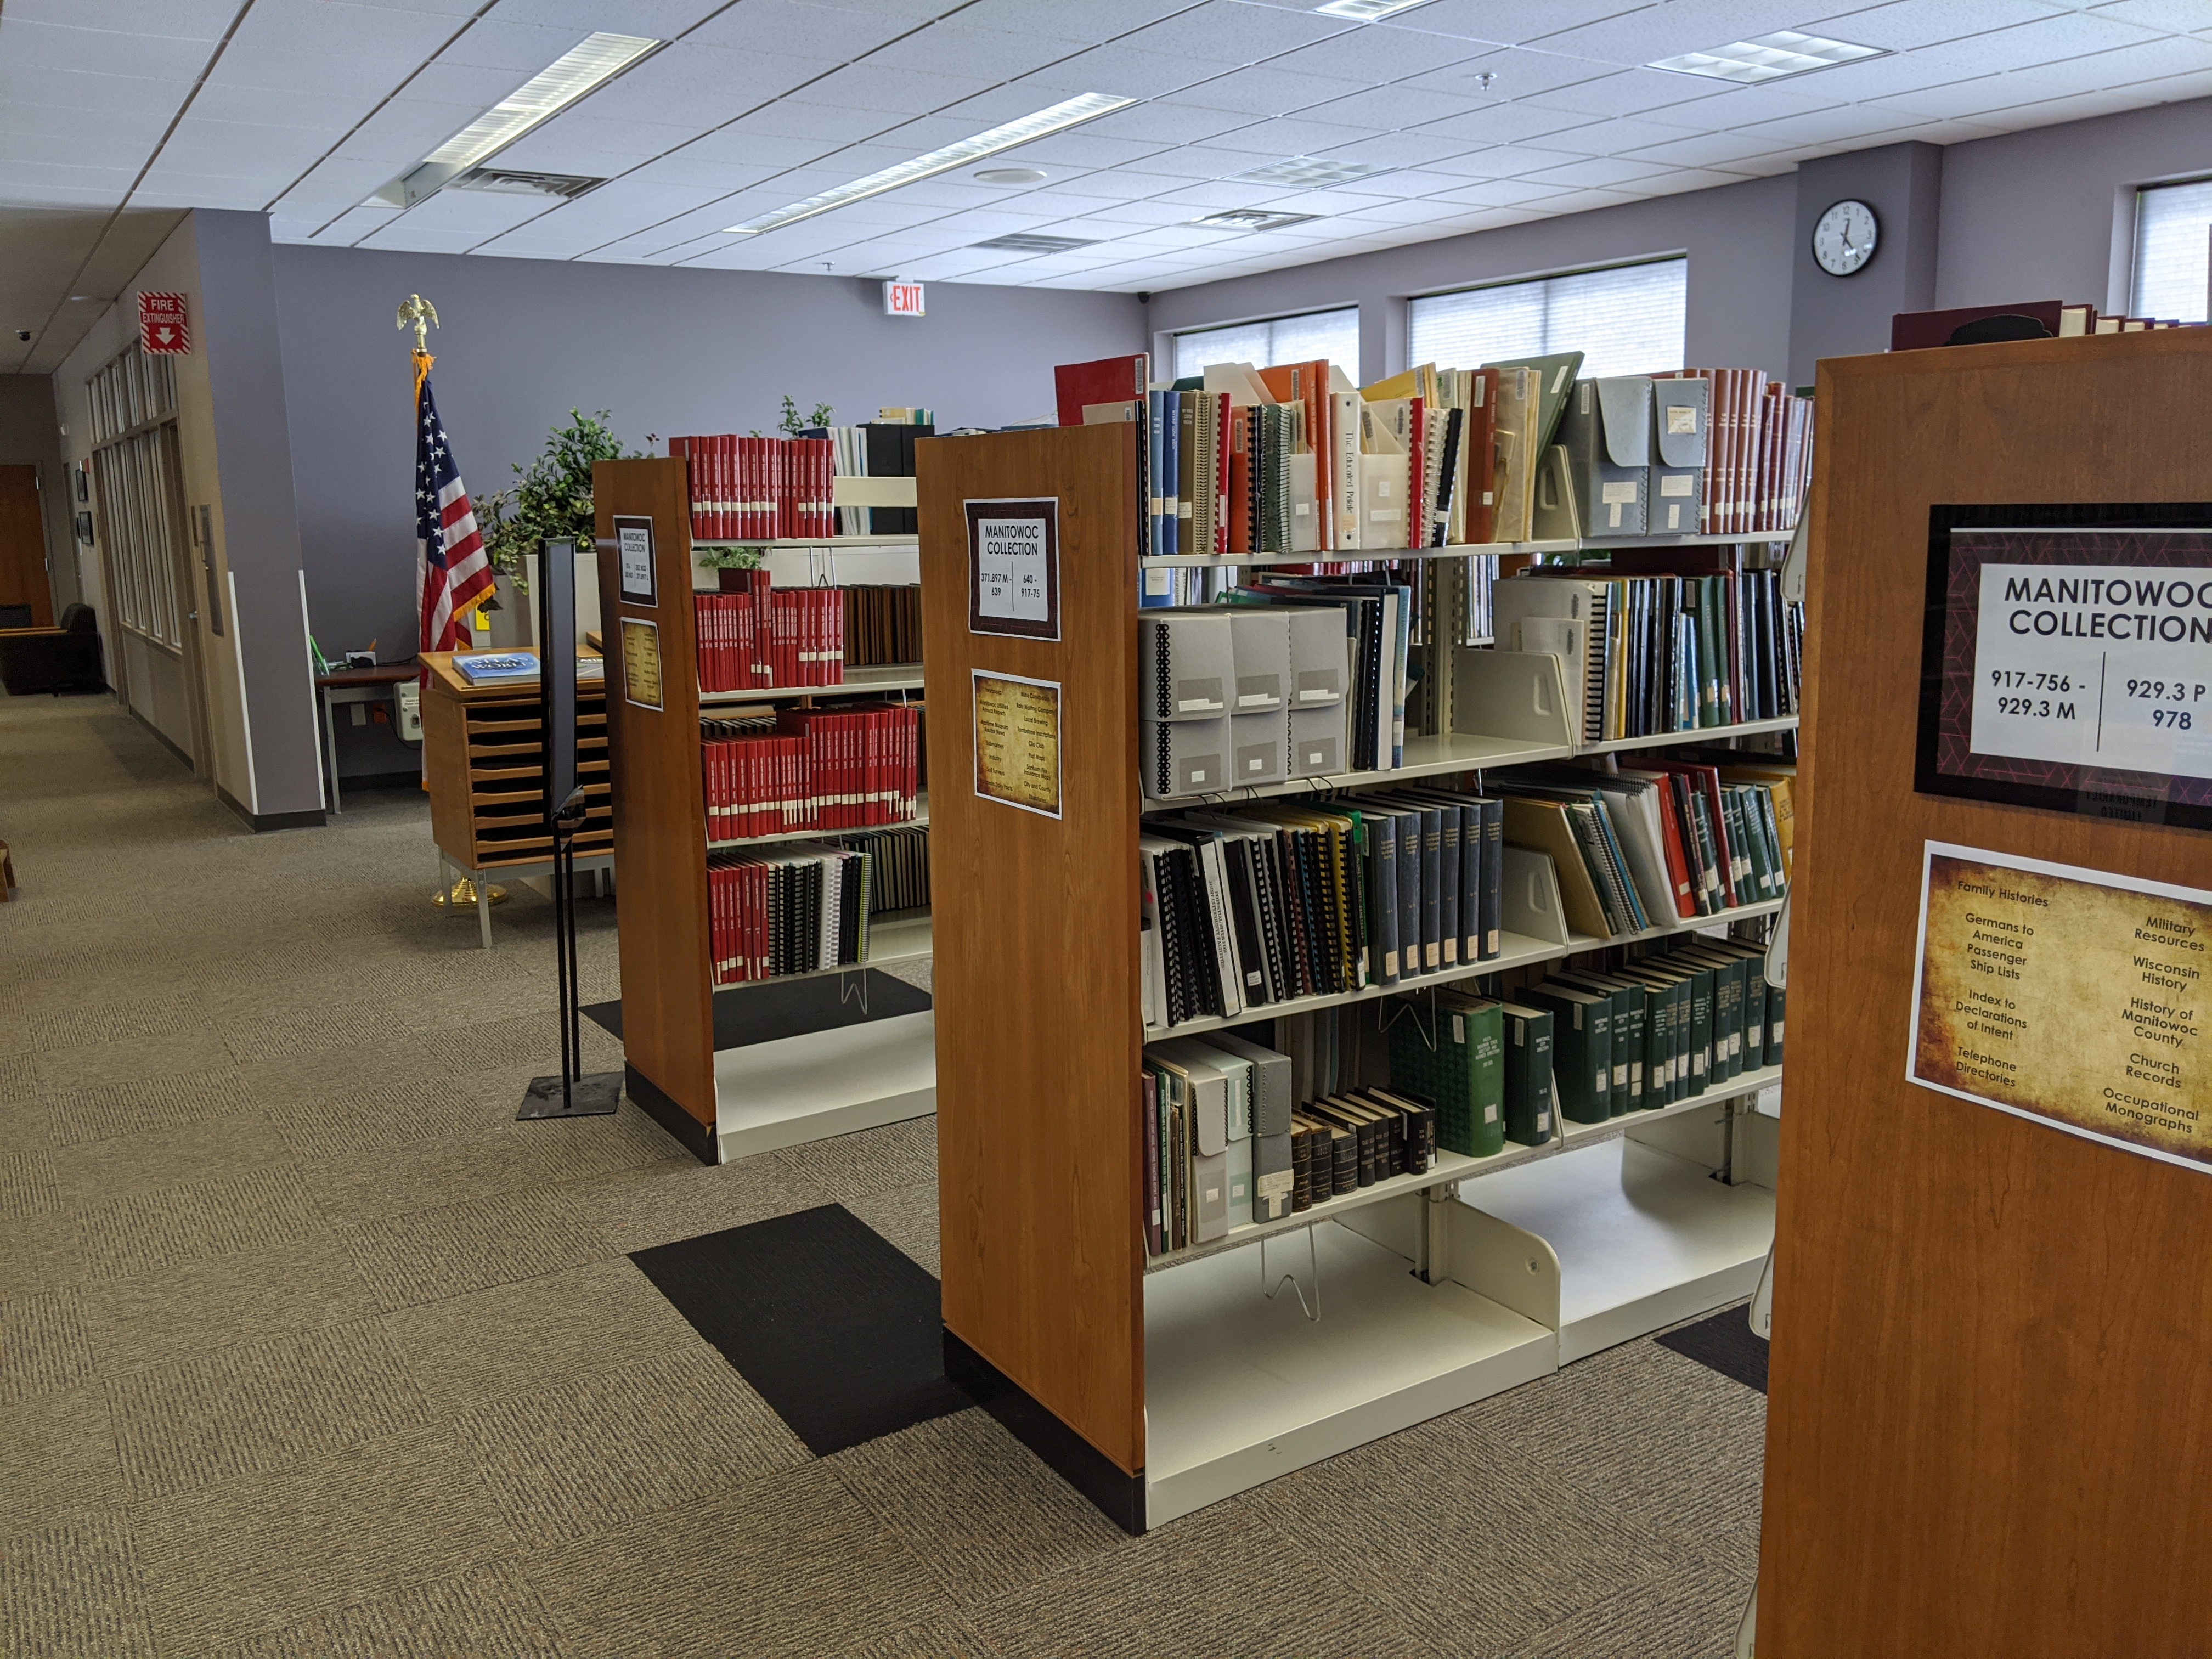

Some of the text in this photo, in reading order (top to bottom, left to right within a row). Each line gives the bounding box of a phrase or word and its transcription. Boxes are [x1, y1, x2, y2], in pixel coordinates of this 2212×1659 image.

[151, 299, 174, 311] FIRE
[893, 286, 920, 312] EXIT
[143, 313, 185, 324] EXTINGUISHER
[1346, 452, 1354, 487] Educated
[985, 526, 1039, 539] MANITOWOC
[987, 542, 1037, 556] COLLECTION
[981, 573, 1002, 583] 371.897
[1002, 574, 1008, 583] M
[1023, 574, 1033, 584] 640
[991, 587, 1001, 596] 639
[1021, 588, 1040, 598] 917-75
[2004, 577, 2212, 608] MANITOWOC
[2009, 609, 2212, 644] COLLECTION
[1991, 670, 2070, 692] 917-756
[2126, 679, 2206, 702] 929.3 P
[1997, 697, 2076, 720] 929.3 M
[2152, 710, 2192, 730] 978
[1957, 881, 2049, 907] Family Histories
[1215, 891, 1223, 924] POTENTIAL
[1211, 899, 1221, 936] CITY/COUNTY
[1217, 936, 1226, 969] FACILITIES
[1965, 912, 2034, 936] Germans to
[2146, 916, 2196, 938] Military
[1973, 930, 2024, 950] America
[2135, 928, 2205, 952] Resources
[1967, 944, 2028, 967] Passenger
[1971, 960, 2021, 980] Ship Lists
[2133, 956, 2200, 980] Wisconsin
[2142, 971, 2188, 993] History
[1969, 989, 2016, 1010] Index to
[2131, 996, 2194, 1021] History of
[1956, 1001, 2028, 1029] Declarations
[2121, 1009, 2198, 1037] Manitowoc
[1967, 1019, 2013, 1041] of Intent
[2134, 1026, 2183, 1048] County
[1957, 1046, 2017, 1073] Telephone
[2130, 1053, 2180, 1075] Church
[1956, 1062, 2016, 1088] Directories
[2126, 1065, 2182, 1088] Records
[2103, 1087, 2199, 1121] Occupational
[2106, 1102, 2193, 1134] Monographs
